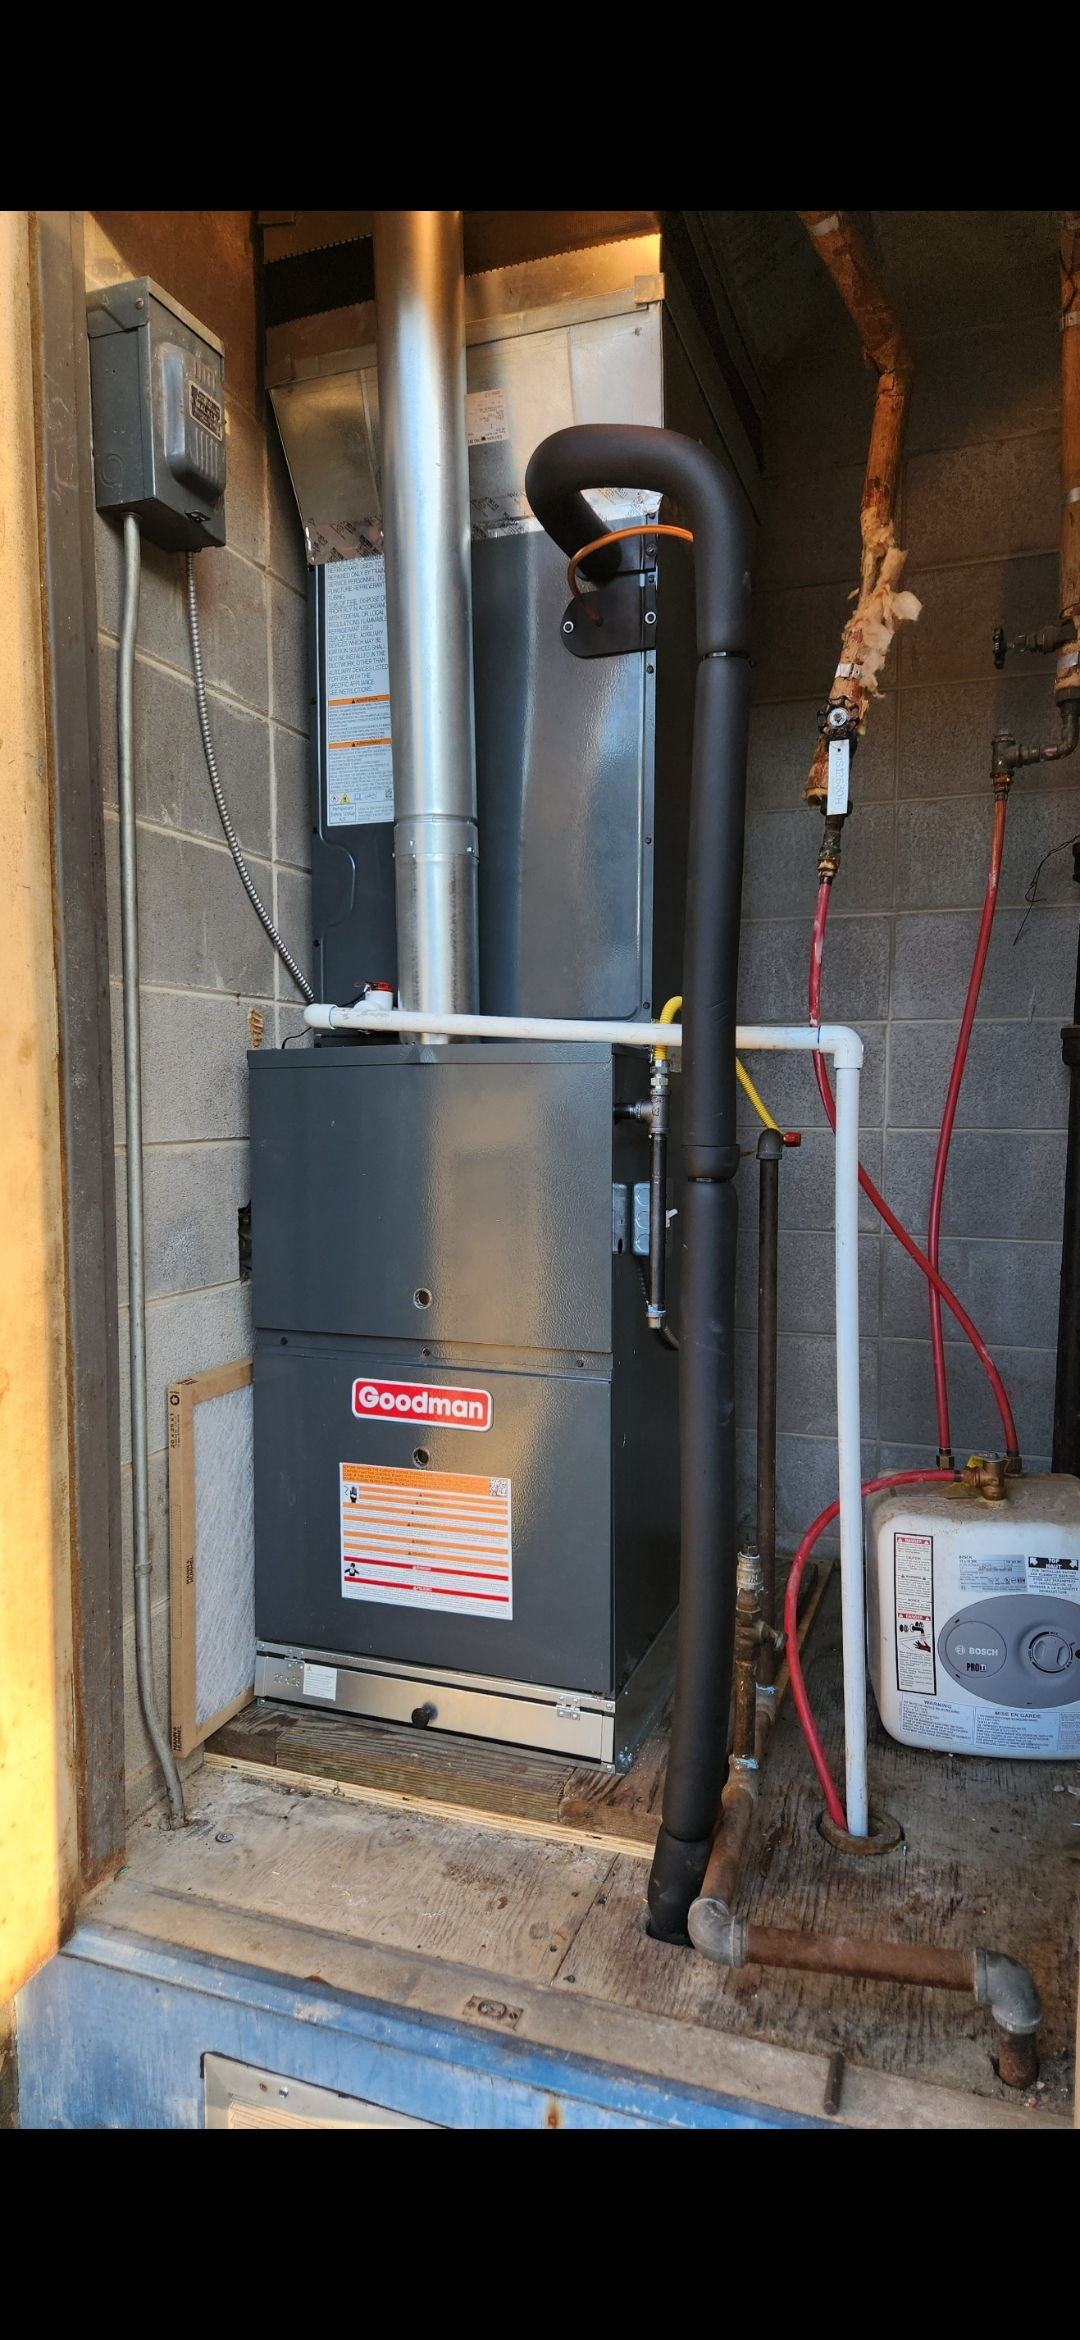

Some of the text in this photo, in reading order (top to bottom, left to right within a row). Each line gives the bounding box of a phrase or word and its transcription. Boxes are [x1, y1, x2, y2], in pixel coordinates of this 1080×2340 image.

[328, 582, 384, 594] PUNCTURE REFRIGERANT
[342, 612, 360, 620] FEDERAL
[328, 626, 360, 634] REFRIGERANT
[346, 652, 370, 660] INSTALLED
[328, 681, 349, 690] SPECIFIC
[359, 1386, 483, 1419] Goodman
[170, 1440, 174, 1448] 20
[969, 1647, 998, 1656] BOSCH
[924, 1700, 952, 1709] WARNING
